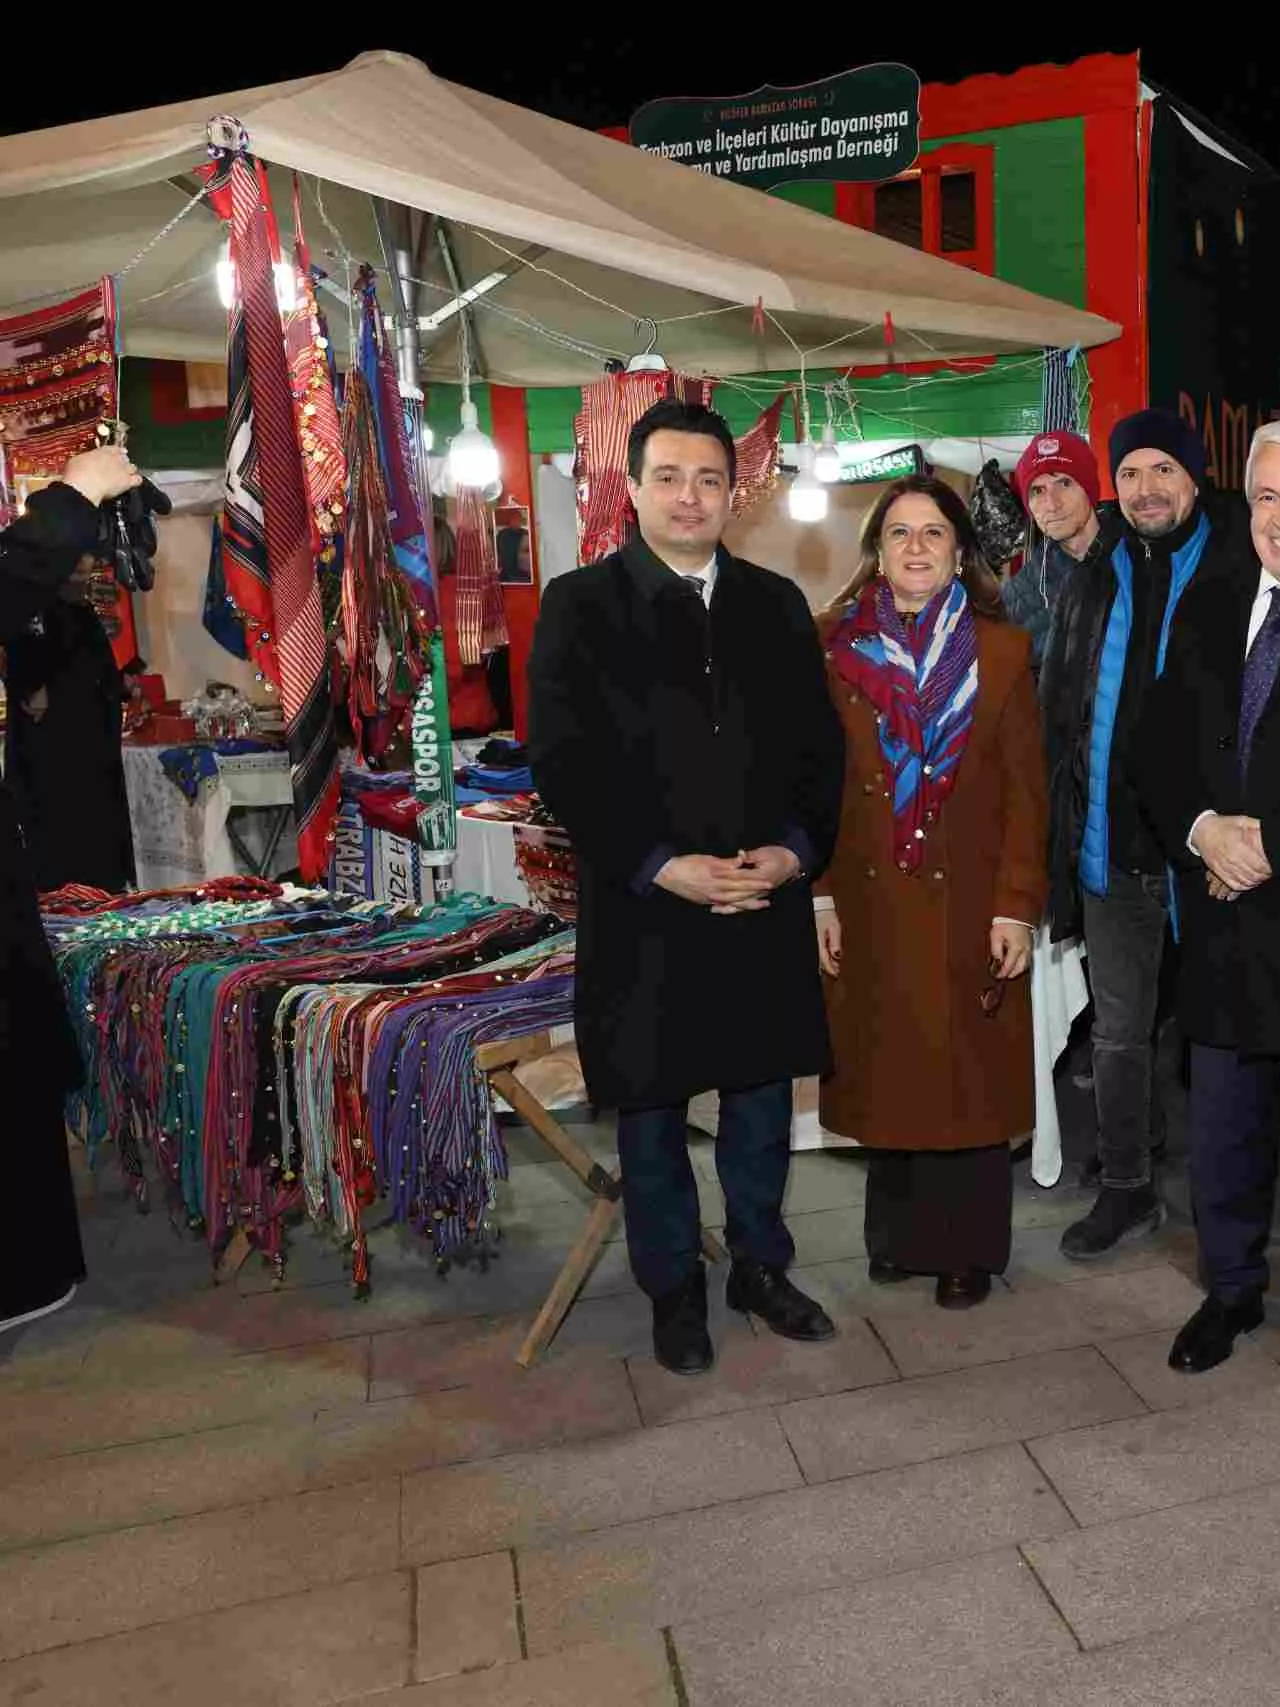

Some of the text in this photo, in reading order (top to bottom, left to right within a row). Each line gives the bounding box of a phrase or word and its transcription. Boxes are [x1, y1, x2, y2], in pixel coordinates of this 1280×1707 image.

[696, 138, 712, 154] ve
[716, 125, 767, 154] İlçeleri
[771, 120, 817, 144] Kültür
[821, 110, 909, 138] Dayanışma
[715, 159, 731, 175] ve
[735, 145, 832, 172] Yardımlaşma
[837, 132, 899, 159] Derneği
[335, 812, 365, 894] TRABZ
